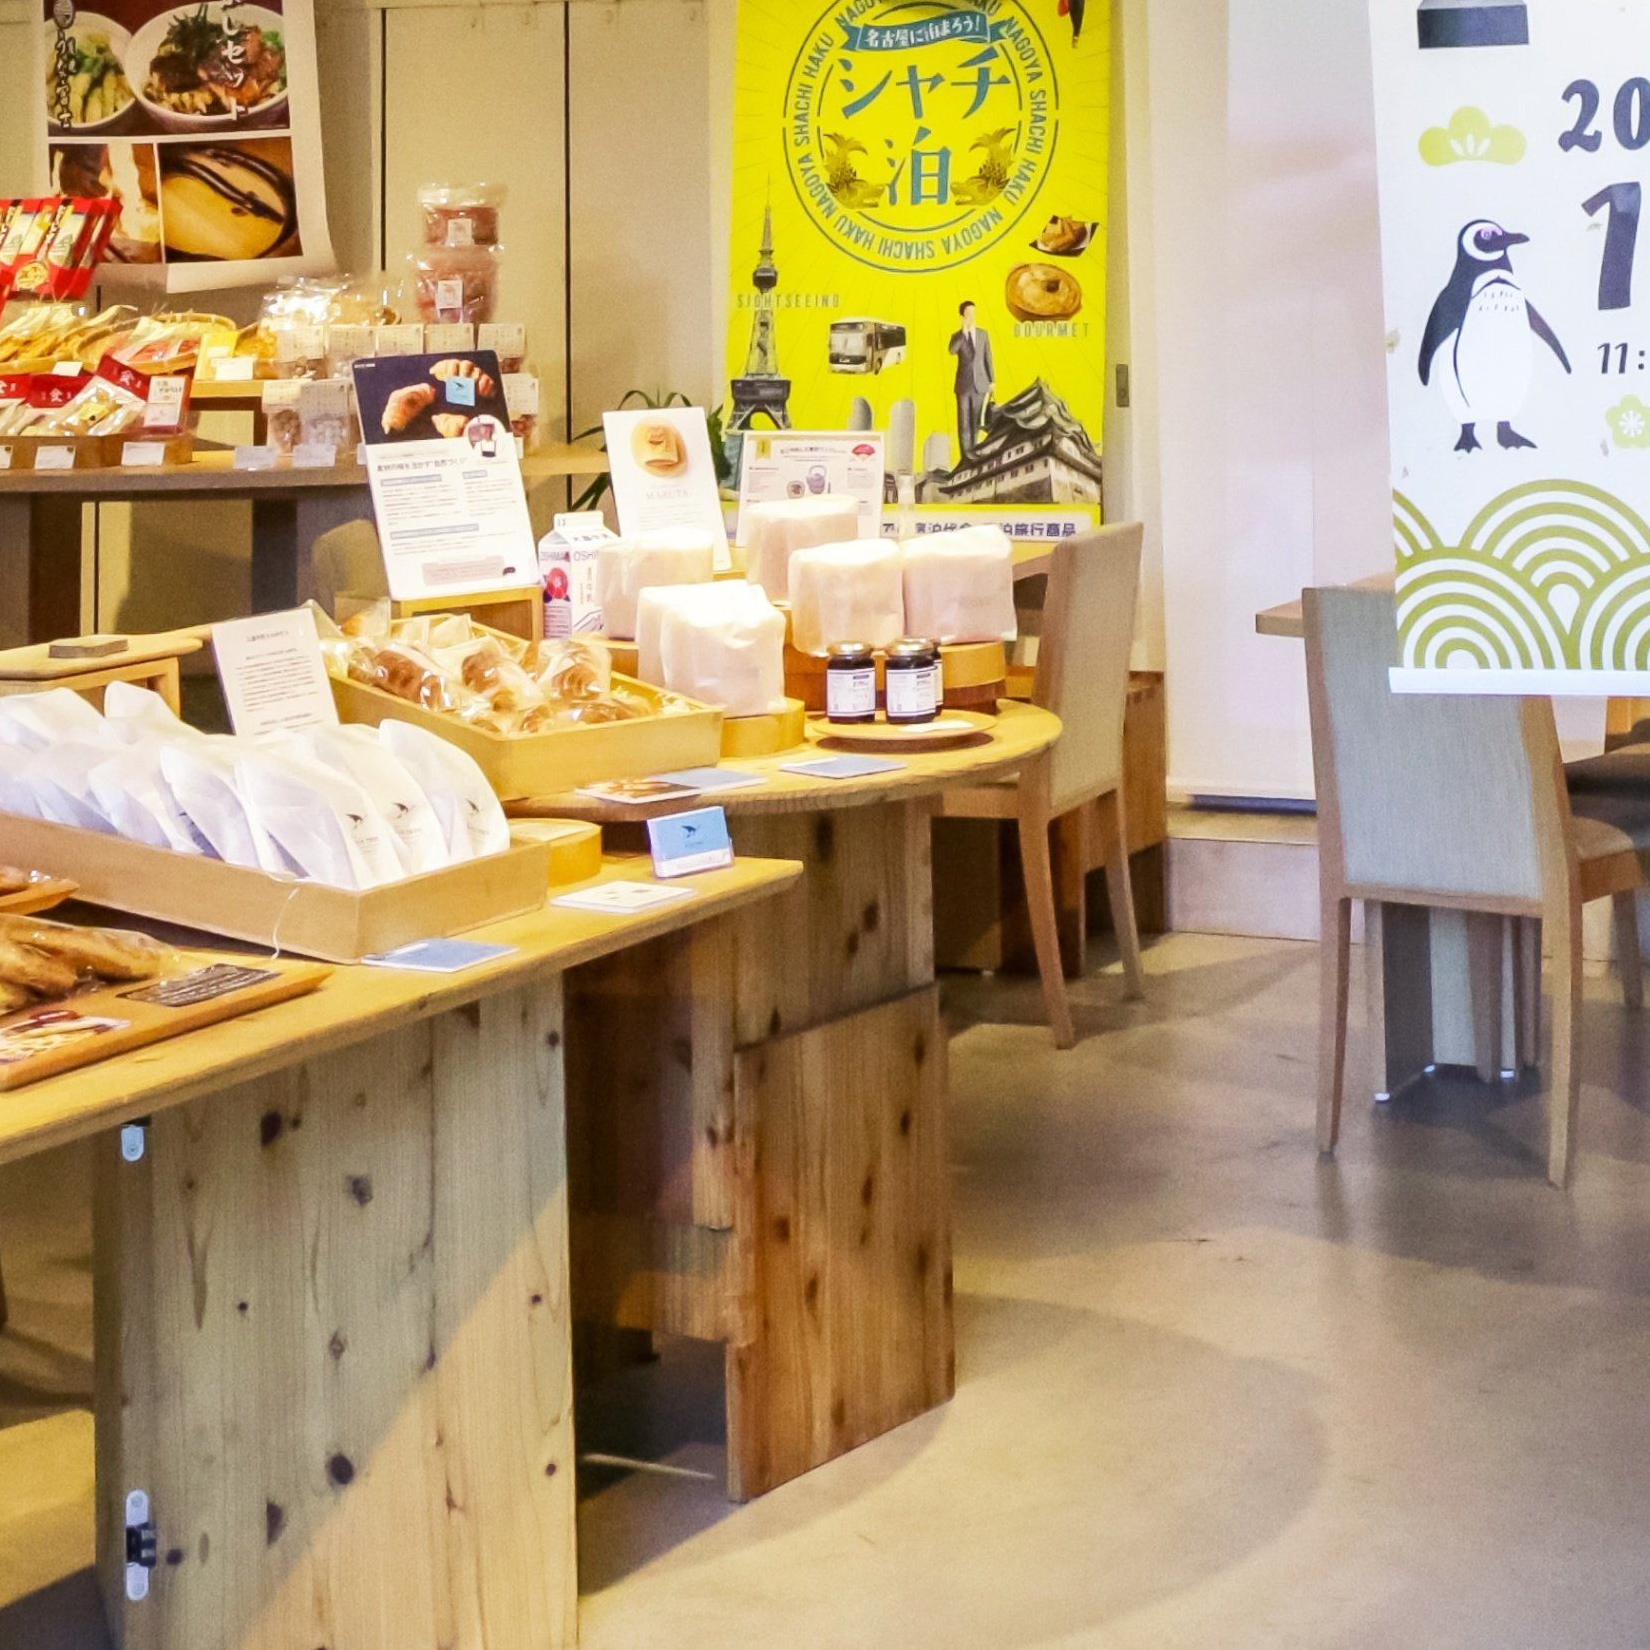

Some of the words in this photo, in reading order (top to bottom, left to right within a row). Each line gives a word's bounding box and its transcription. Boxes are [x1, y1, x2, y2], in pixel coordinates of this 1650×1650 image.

[803, 32, 835, 79] HAKU
[1004, 16, 1043, 84] NAGOYA
[837, 45, 1012, 120] シャチ
[794, 82, 814, 148] SHACHI
[1026, 88, 1047, 155] SHACHI
[797, 152, 838, 220] NAGOYA
[883, 125, 953, 207] 泊
[1004, 158, 1038, 206] HAKU
[833, 215, 875, 251] HAKU
[878, 237, 935, 260] SHACHI
[941, 207, 1004, 256] NAGOYA
[736, 294, 840, 309] SIGHTSEEING
[1014, 322, 1090, 338] GOURMET
